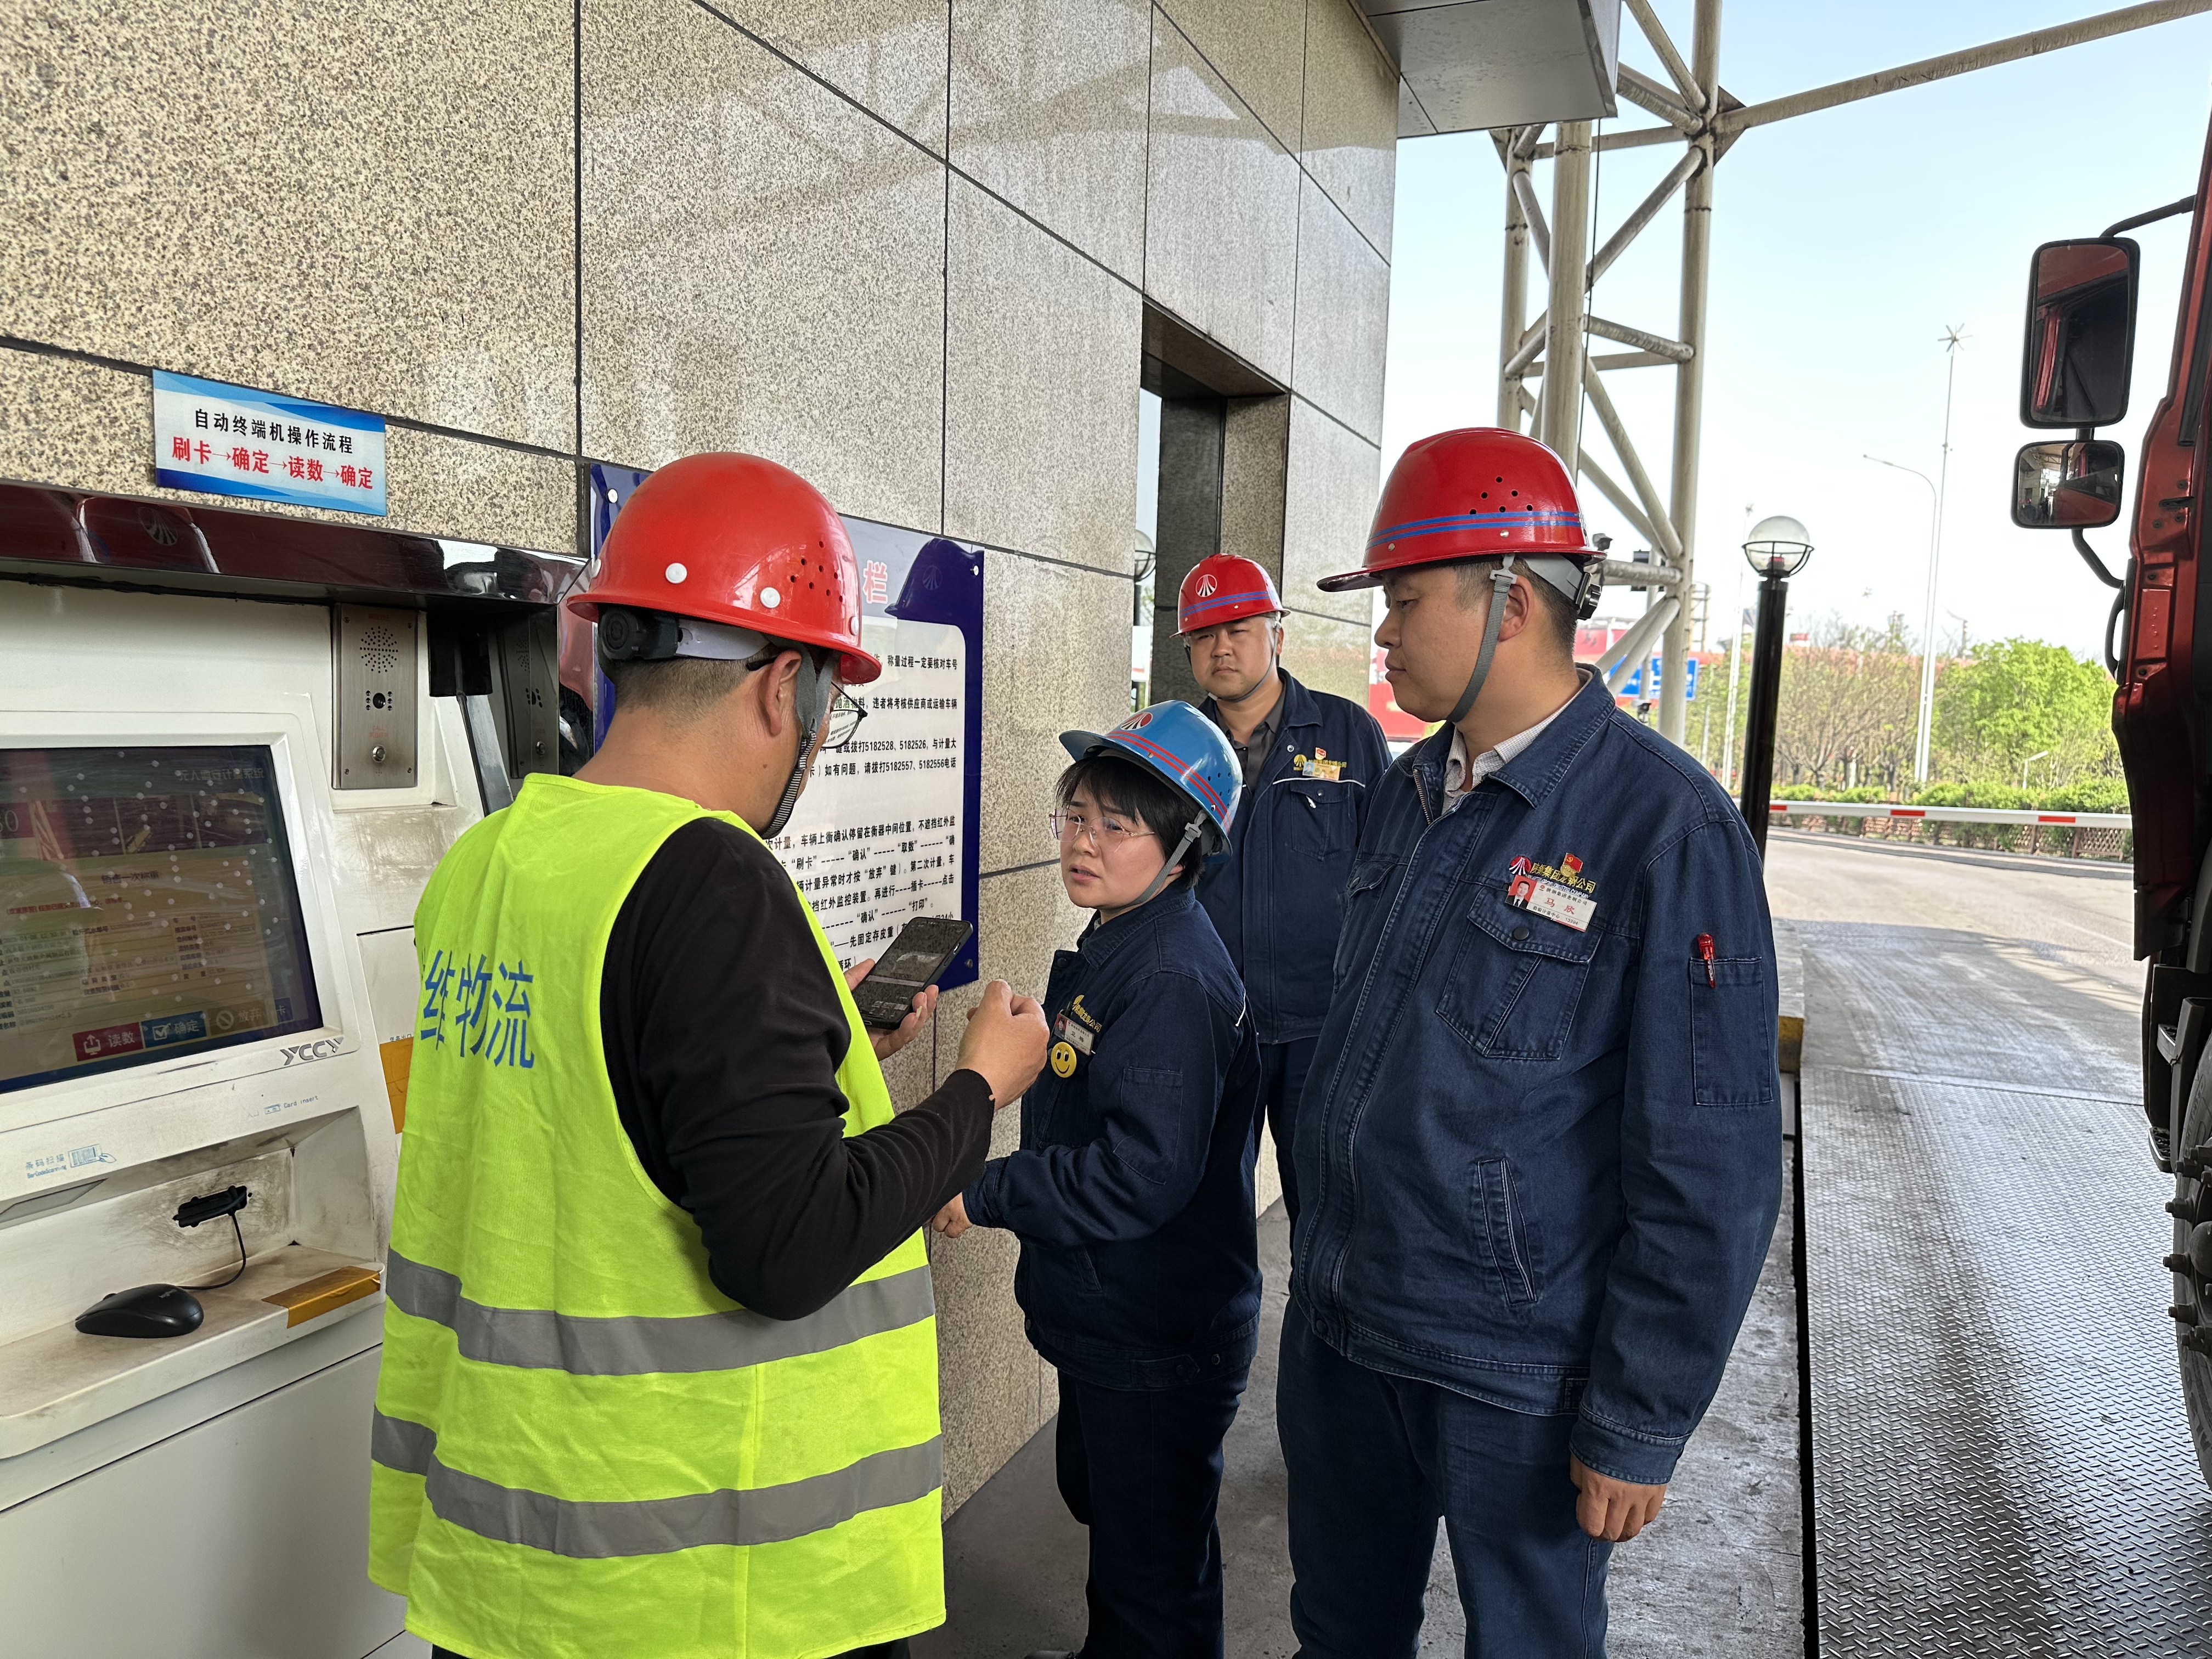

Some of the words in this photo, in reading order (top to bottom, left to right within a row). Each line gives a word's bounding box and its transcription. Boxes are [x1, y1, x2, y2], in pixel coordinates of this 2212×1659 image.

[195, 409, 352, 454] 自动终端机操作流程
[172, 436, 212, 464] 刷卡
[232, 447, 269, 474] 确定
[288, 455, 323, 482] 读数
[340, 465, 373, 489] 确定
[863, 560, 888, 603] 栏
[238, 1007, 262, 1023] 放弃
[421, 949, 534, 1068] 维物流
[108, 1031, 135, 1048] 读数
[174, 1020, 200, 1035] 确定
[300, 1096, 319, 1104] insert
